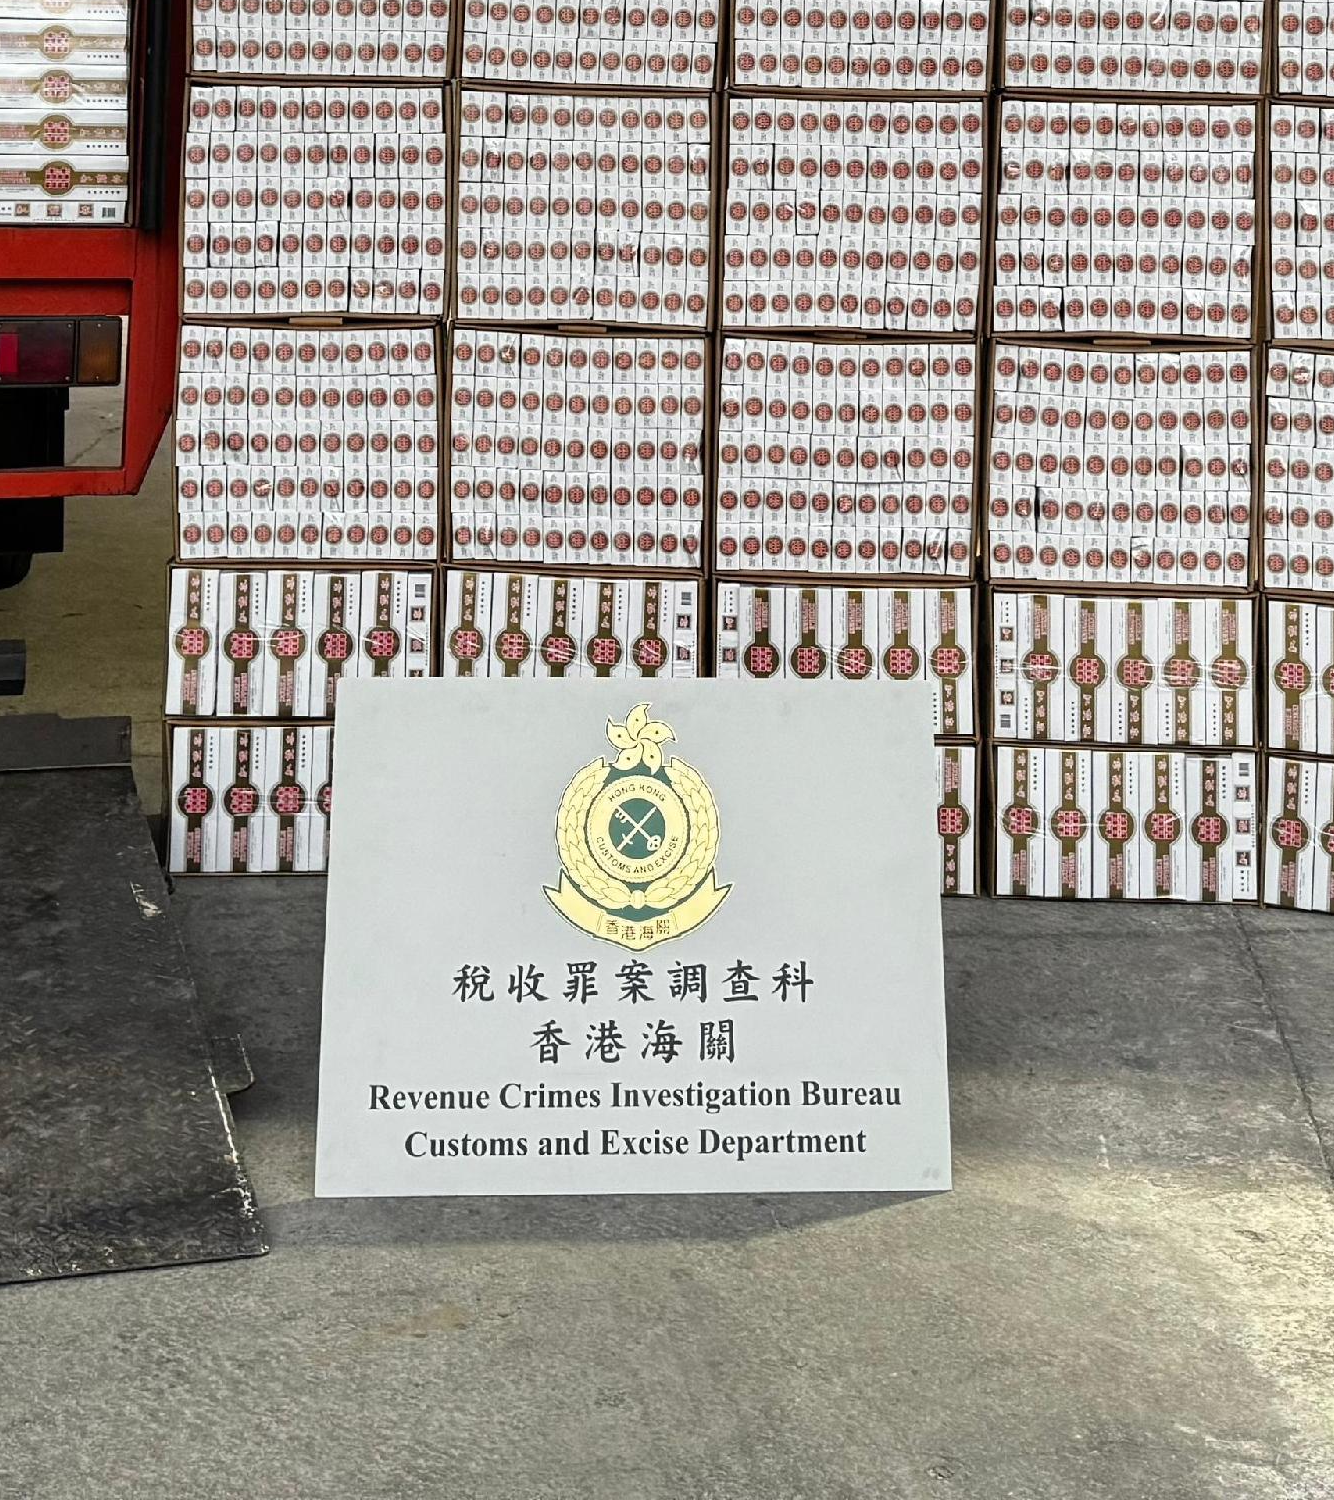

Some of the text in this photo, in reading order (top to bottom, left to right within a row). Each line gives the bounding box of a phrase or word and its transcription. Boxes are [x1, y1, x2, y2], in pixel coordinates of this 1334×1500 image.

[608, 783, 665, 802] HONG KONG
[596, 835, 679, 874] CUSTOMS AND EXCISE
[530, 1018, 735, 1064] 香港海關
[369, 1080, 902, 1114] Revenue Crimes Investigation Bureau
[404, 1129, 867, 1161] Customs and Excise Department
